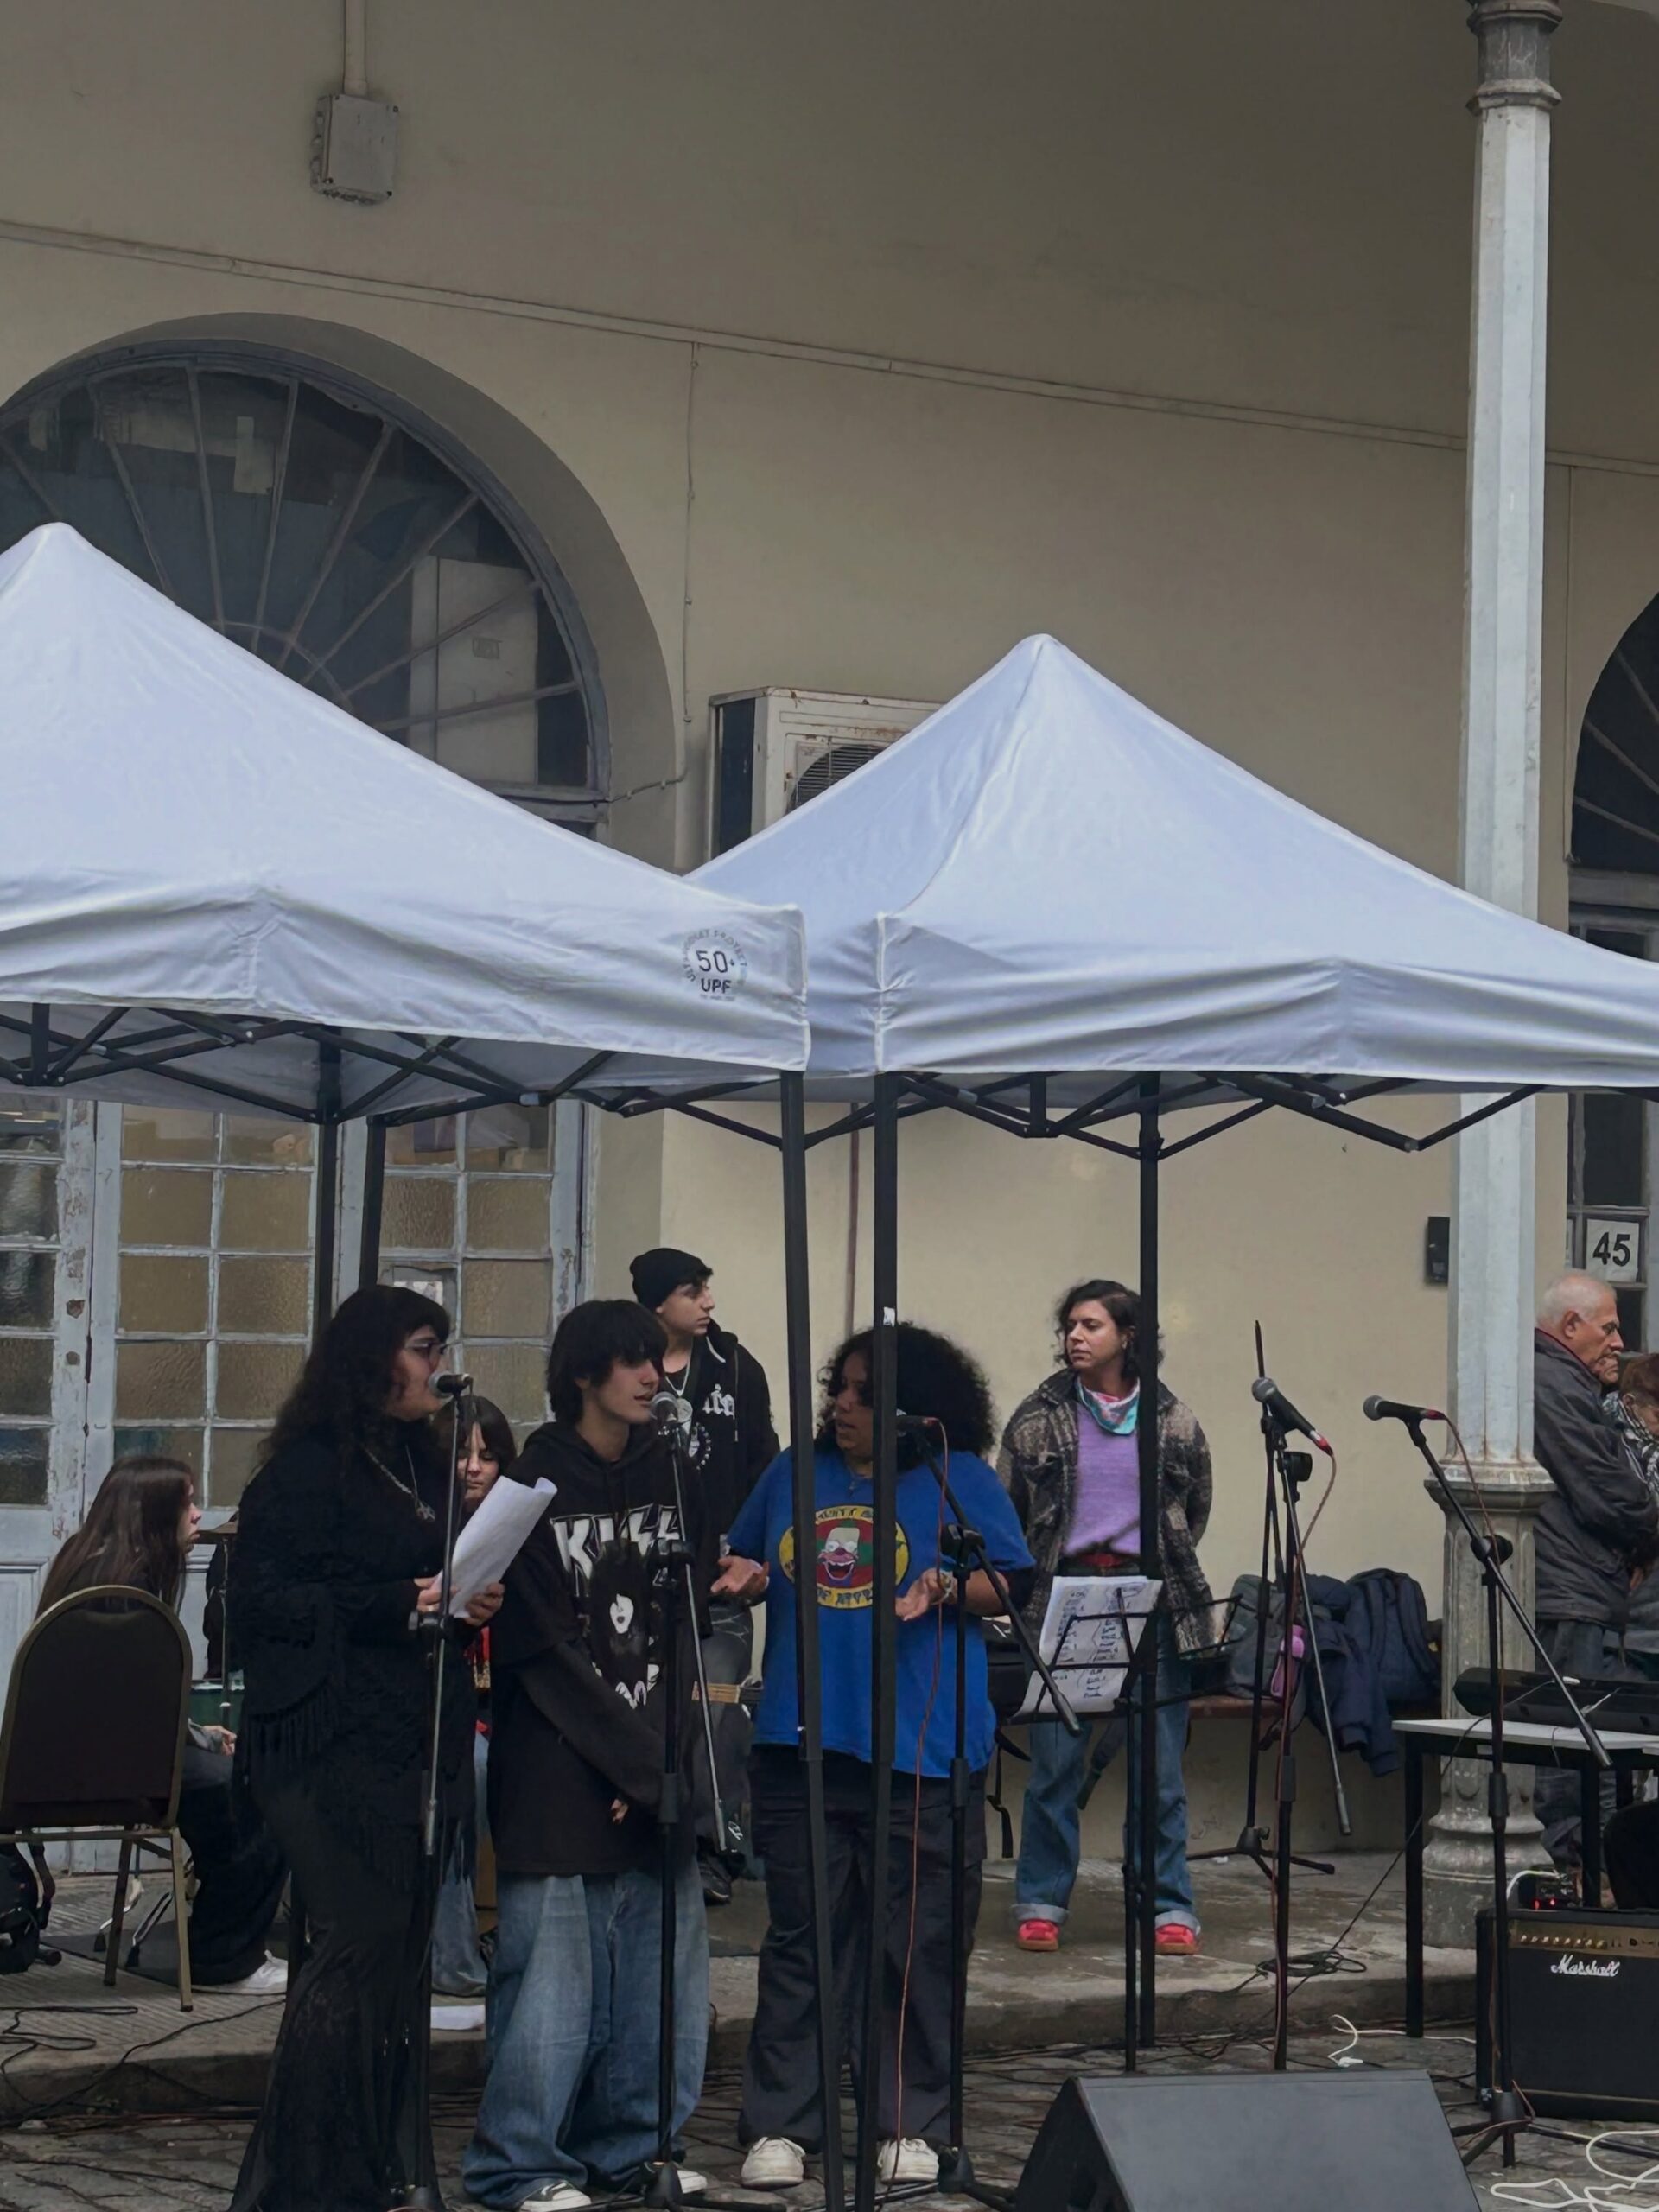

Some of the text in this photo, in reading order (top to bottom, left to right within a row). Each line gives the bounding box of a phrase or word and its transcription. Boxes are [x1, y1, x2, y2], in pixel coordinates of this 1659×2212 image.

[700, 977, 731, 994] UPF
[1592, 1231, 1630, 1268] 45
[1550, 1953, 1621, 1977] Marshall
